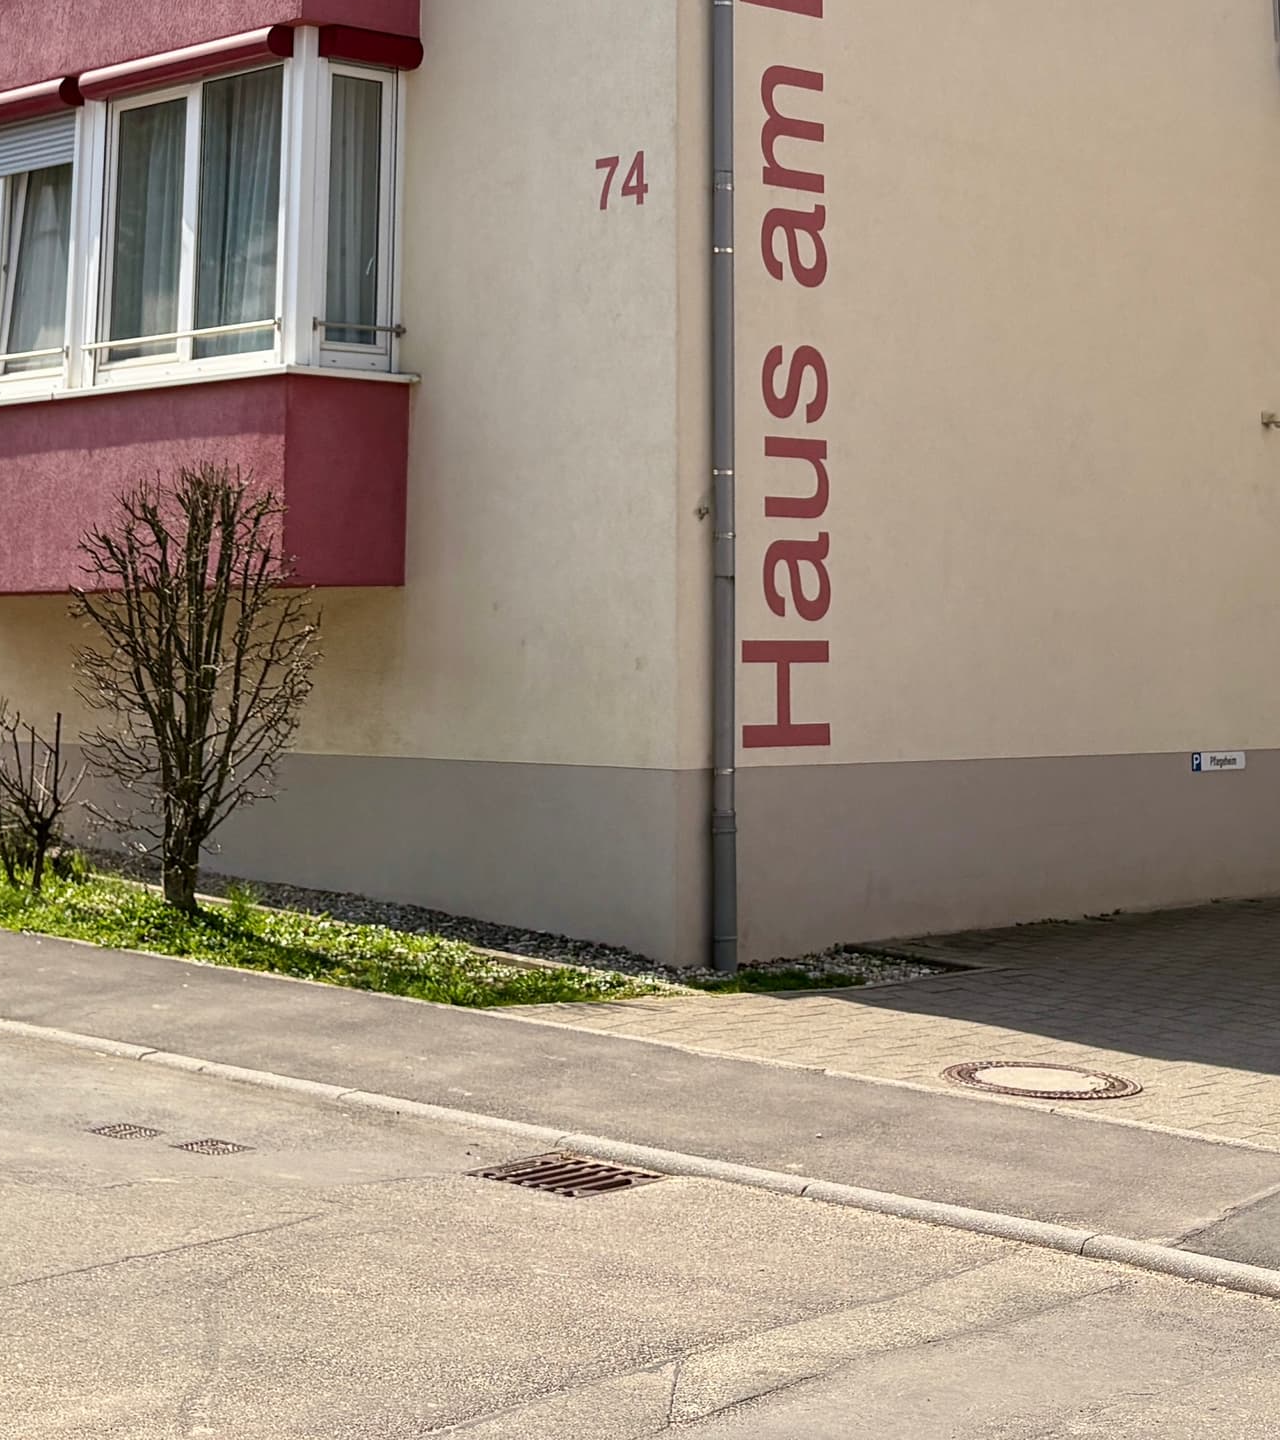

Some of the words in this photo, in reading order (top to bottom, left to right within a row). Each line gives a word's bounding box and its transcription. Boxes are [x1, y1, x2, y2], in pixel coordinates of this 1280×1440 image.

[595, 150, 648, 210] 74
[762, 65, 827, 289] am
[743, 345, 830, 748] Haus
